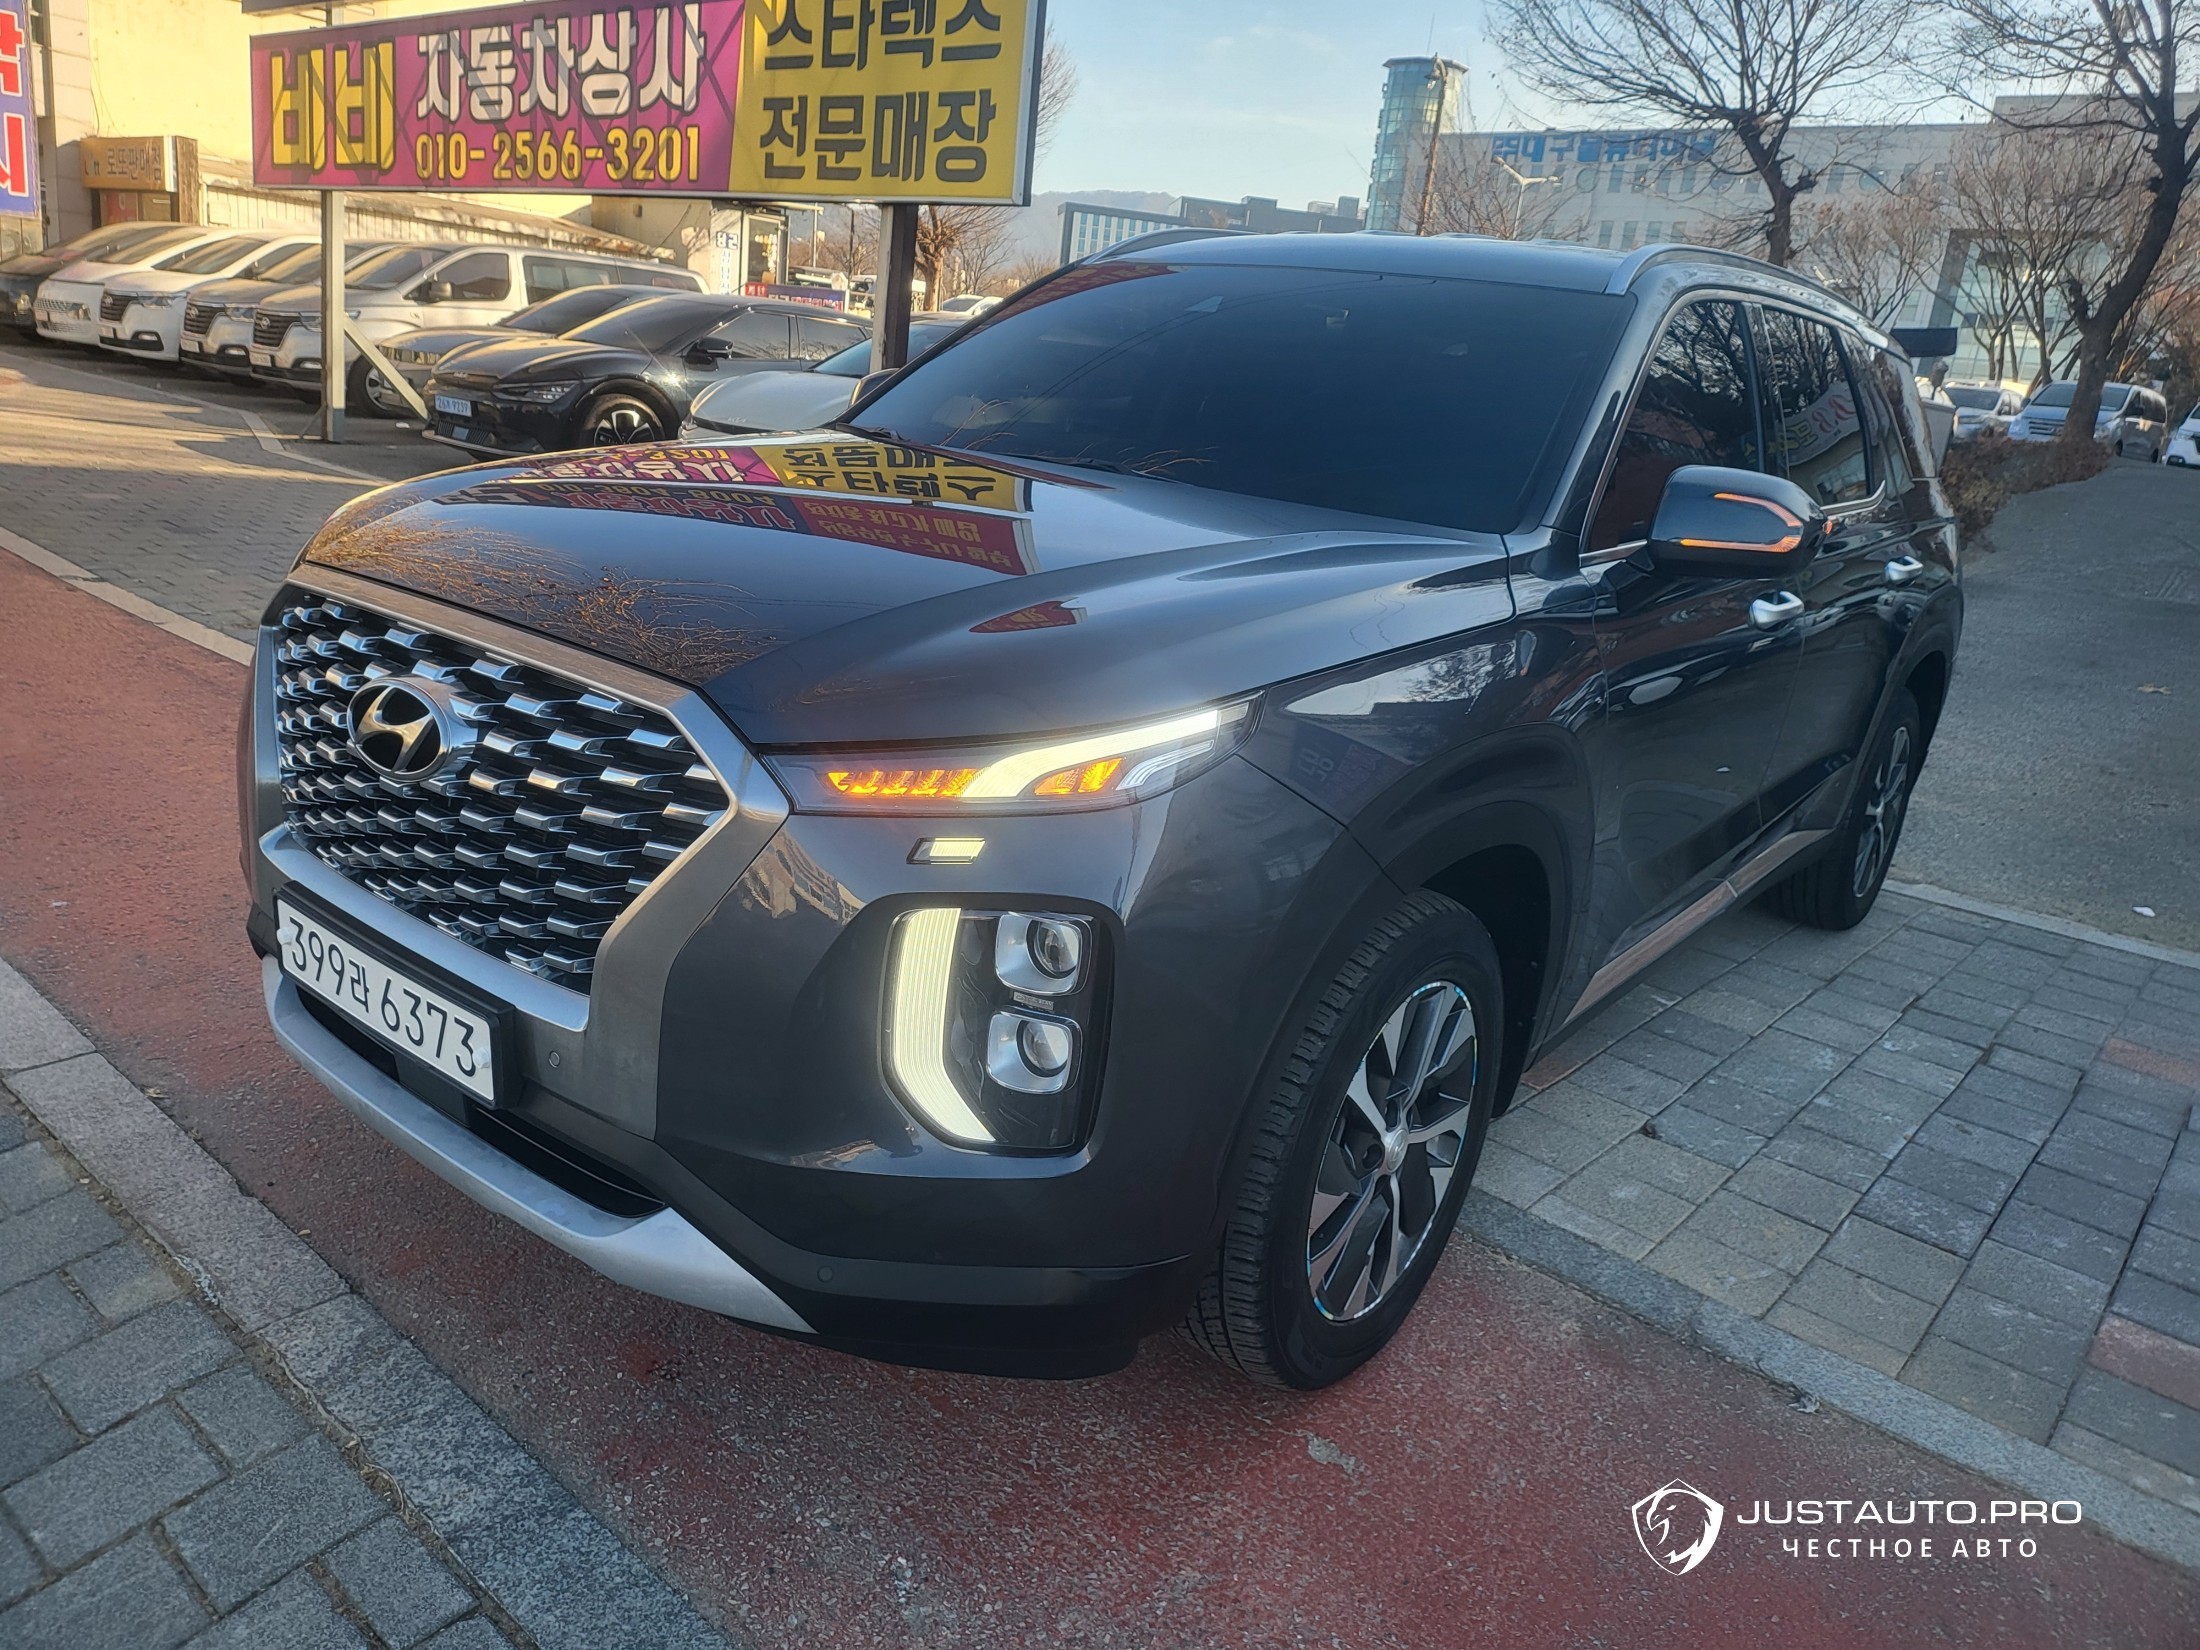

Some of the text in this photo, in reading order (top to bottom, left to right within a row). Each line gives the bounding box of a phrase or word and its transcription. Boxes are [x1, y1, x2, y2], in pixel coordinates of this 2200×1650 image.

[764, 0, 1003, 71] 스타렉스
[271, 4, 706, 171] 비비 자동차상사
[415, 126, 700, 182] 010-2566-3201
[759, 88, 998, 183] 전문매장
[289, 915, 476, 1078] 399라 6373
